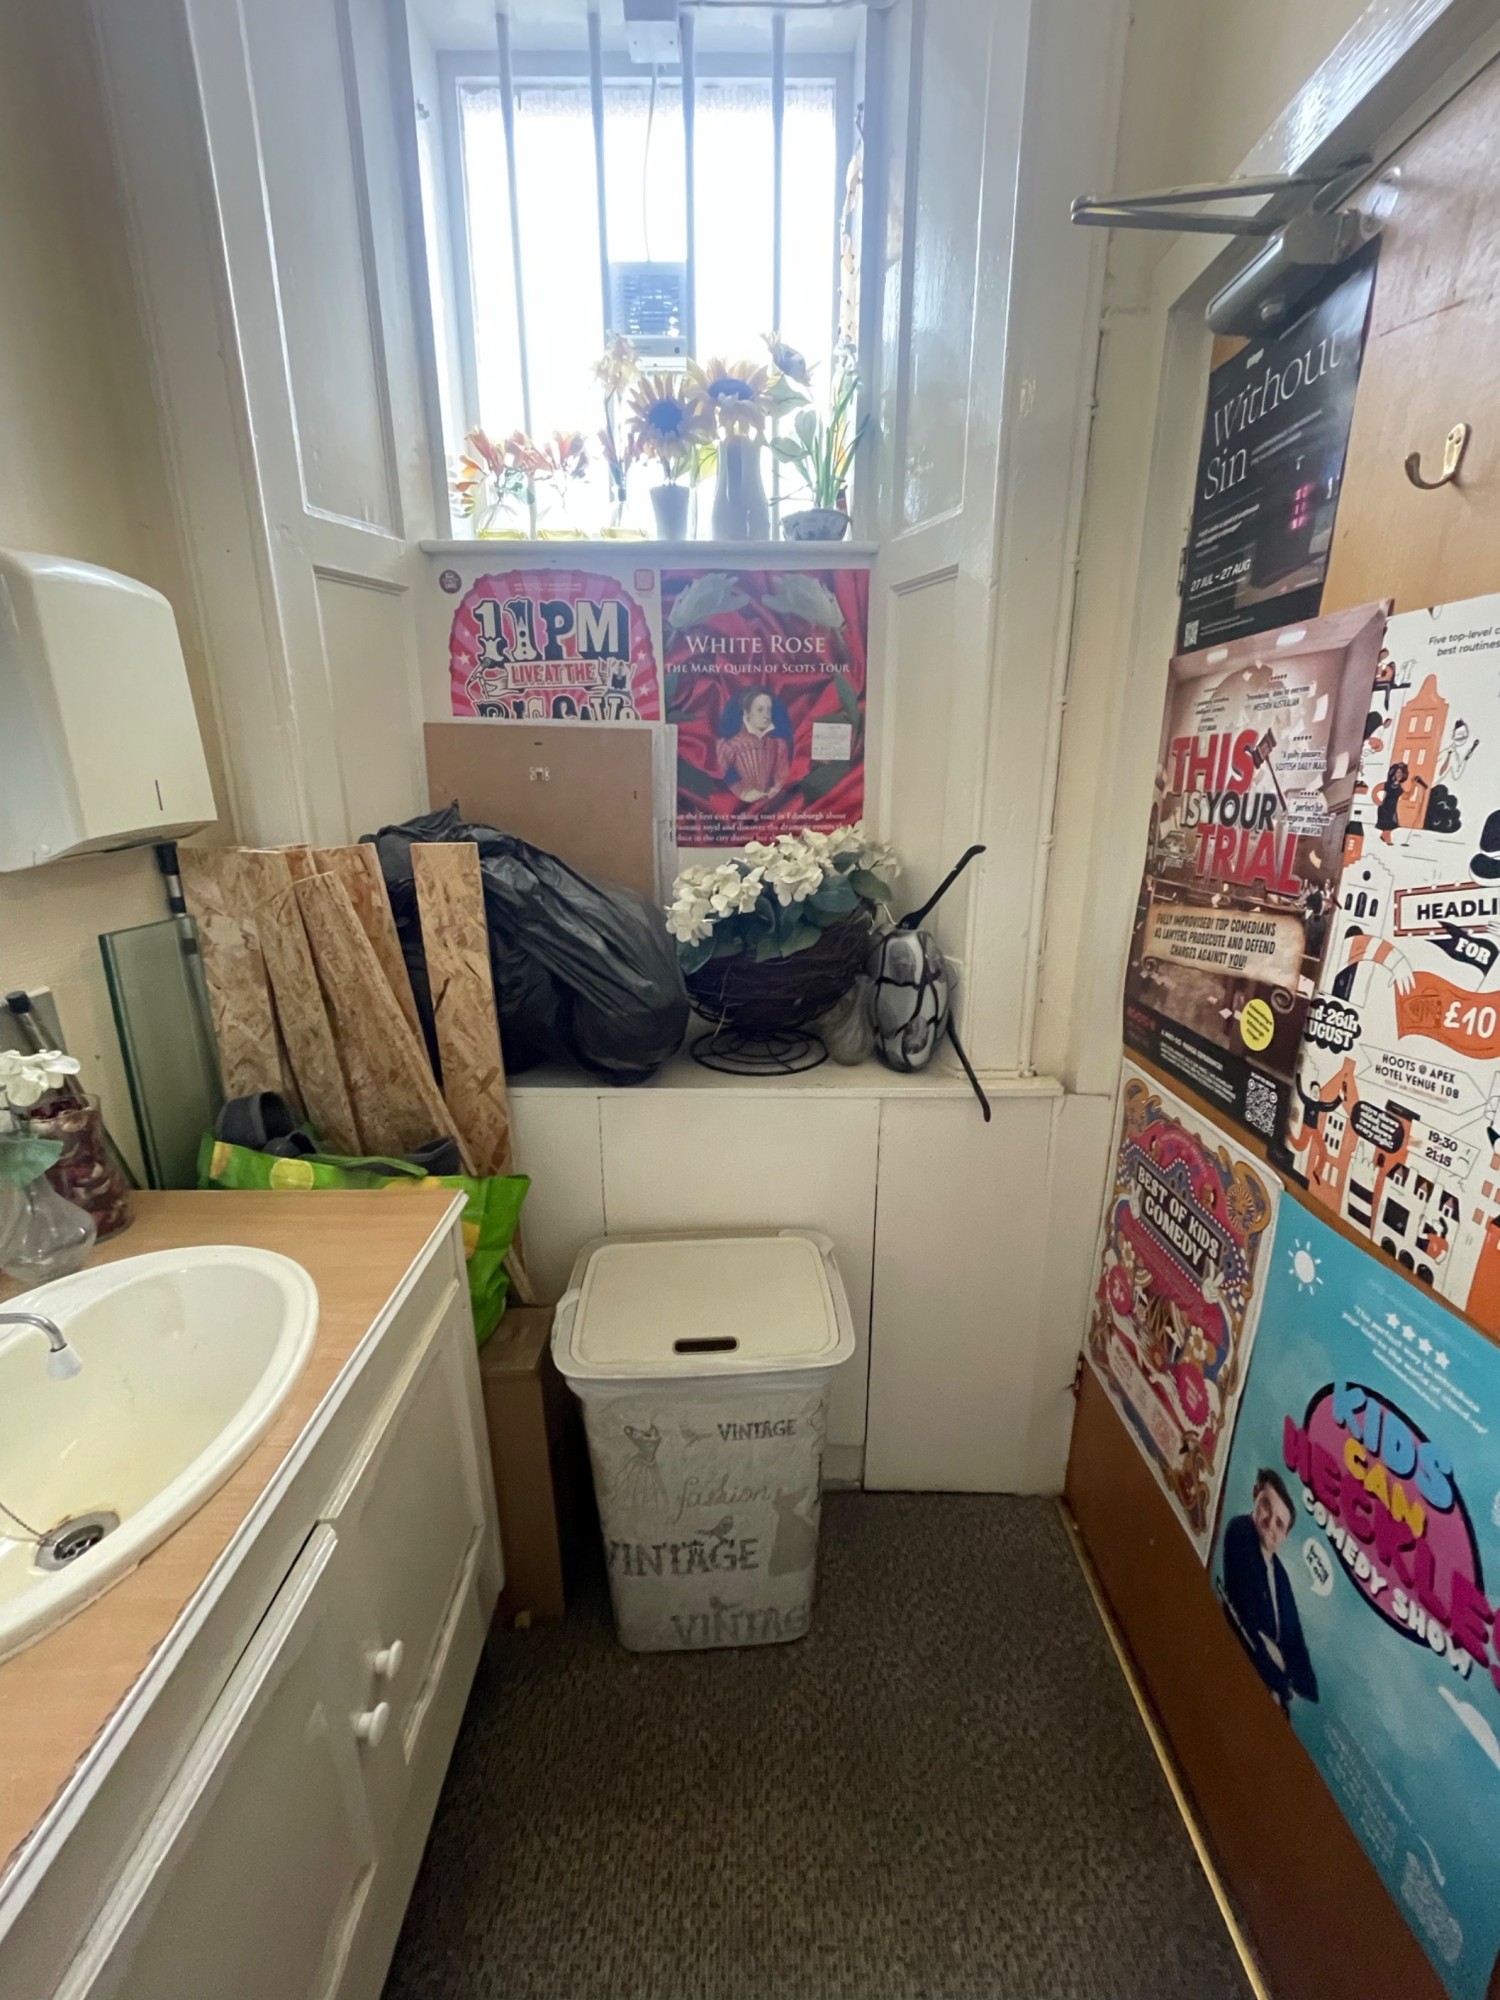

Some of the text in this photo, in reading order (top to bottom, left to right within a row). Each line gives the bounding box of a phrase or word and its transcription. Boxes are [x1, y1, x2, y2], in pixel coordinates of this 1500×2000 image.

[1214, 330, 1343, 446] Without
[1190, 579, 1201, 592] 27
[1200, 574, 1214, 588] JUL
[1220, 566, 1233, 580] 27
[1232, 558, 1252, 575] AUG
[473, 597, 630, 668] 11PM
[686, 635, 825, 654] WHITE ROSE
[1428, 636, 1447, 645] Five
[1449, 626, 1493, 643] top-level
[1437, 646, 1457, 657] best
[511, 662, 597, 684] LIVE AT THE
[665, 663, 688, 673] THE
[691, 664, 721, 674] MARY
[724, 663, 761, 675] QUEEN
[782, 663, 815, 673] SCOTS
[819, 663, 850, 674] TOUR
[1172, 729, 1258, 795] THIS
[731, 812, 759, 823] walking
[787, 811, 824, 822] Edinburgh
[1181, 790, 1277, 832] IS YOUR
[1197, 822, 1301, 895] TRIAL
[1417, 898, 1500, 920] HEADLI
[1156, 913, 1277, 936] FULLY IMPROVISED! TOP COMEDIANS
[1154, 927, 1276, 955] AS LAWYERS PROSECUTE AND DEFEND
[1455, 937, 1492, 966] FOR
[1170, 944, 1248, 969] CHARGES AGAINST YOU!
[1308, 1019, 1353, 1048] UGUST
[1443, 1001, 1497, 1039] £10
[1375, 1064, 1403, 1081] HOTEL
[1405, 1073, 1437, 1092] VENUE
[1440, 1084, 1460, 1099] 108
[1382, 1053, 1456, 1084] HOOTS @ APEX
[1428, 1130, 1458, 1152] 19:30
[1425, 1147, 1453, 1168] 21:15
[1137, 1165, 1220, 1260] BEST OF KIDS
[1145, 1195, 1202, 1267] COMEDY
[717, 1418, 797, 1442] VINTAGE
[1333, 1381, 1455, 1513] KIDS
[1344, 1437, 1427, 1539] CAN
[1302, 1486, 1387, 1598] COMEDY
[1392, 1587, 1473, 1680] SHOW
[670, 1603, 808, 1646] VINTAG
